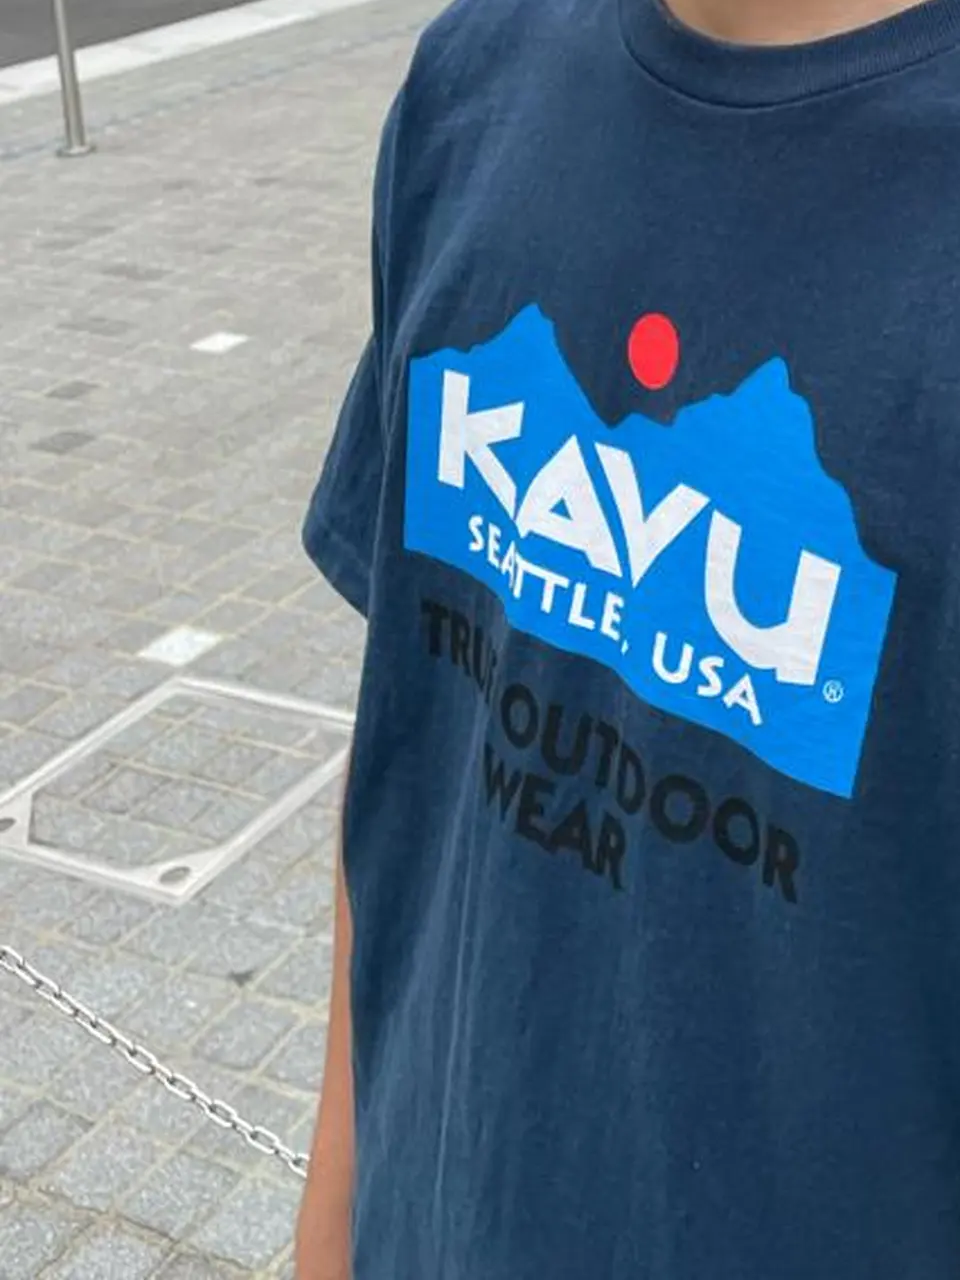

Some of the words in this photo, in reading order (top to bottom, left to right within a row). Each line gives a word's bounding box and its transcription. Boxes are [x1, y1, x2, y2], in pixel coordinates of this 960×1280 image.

[437, 369, 841, 686] KAVU
[467, 516, 629, 655] SEATTLE,
[651, 632, 764, 726] USA
[420, 597, 499, 704] TRU
[500, 682, 801, 904] OUTDOOR
[483, 740, 628, 890] WEAR
